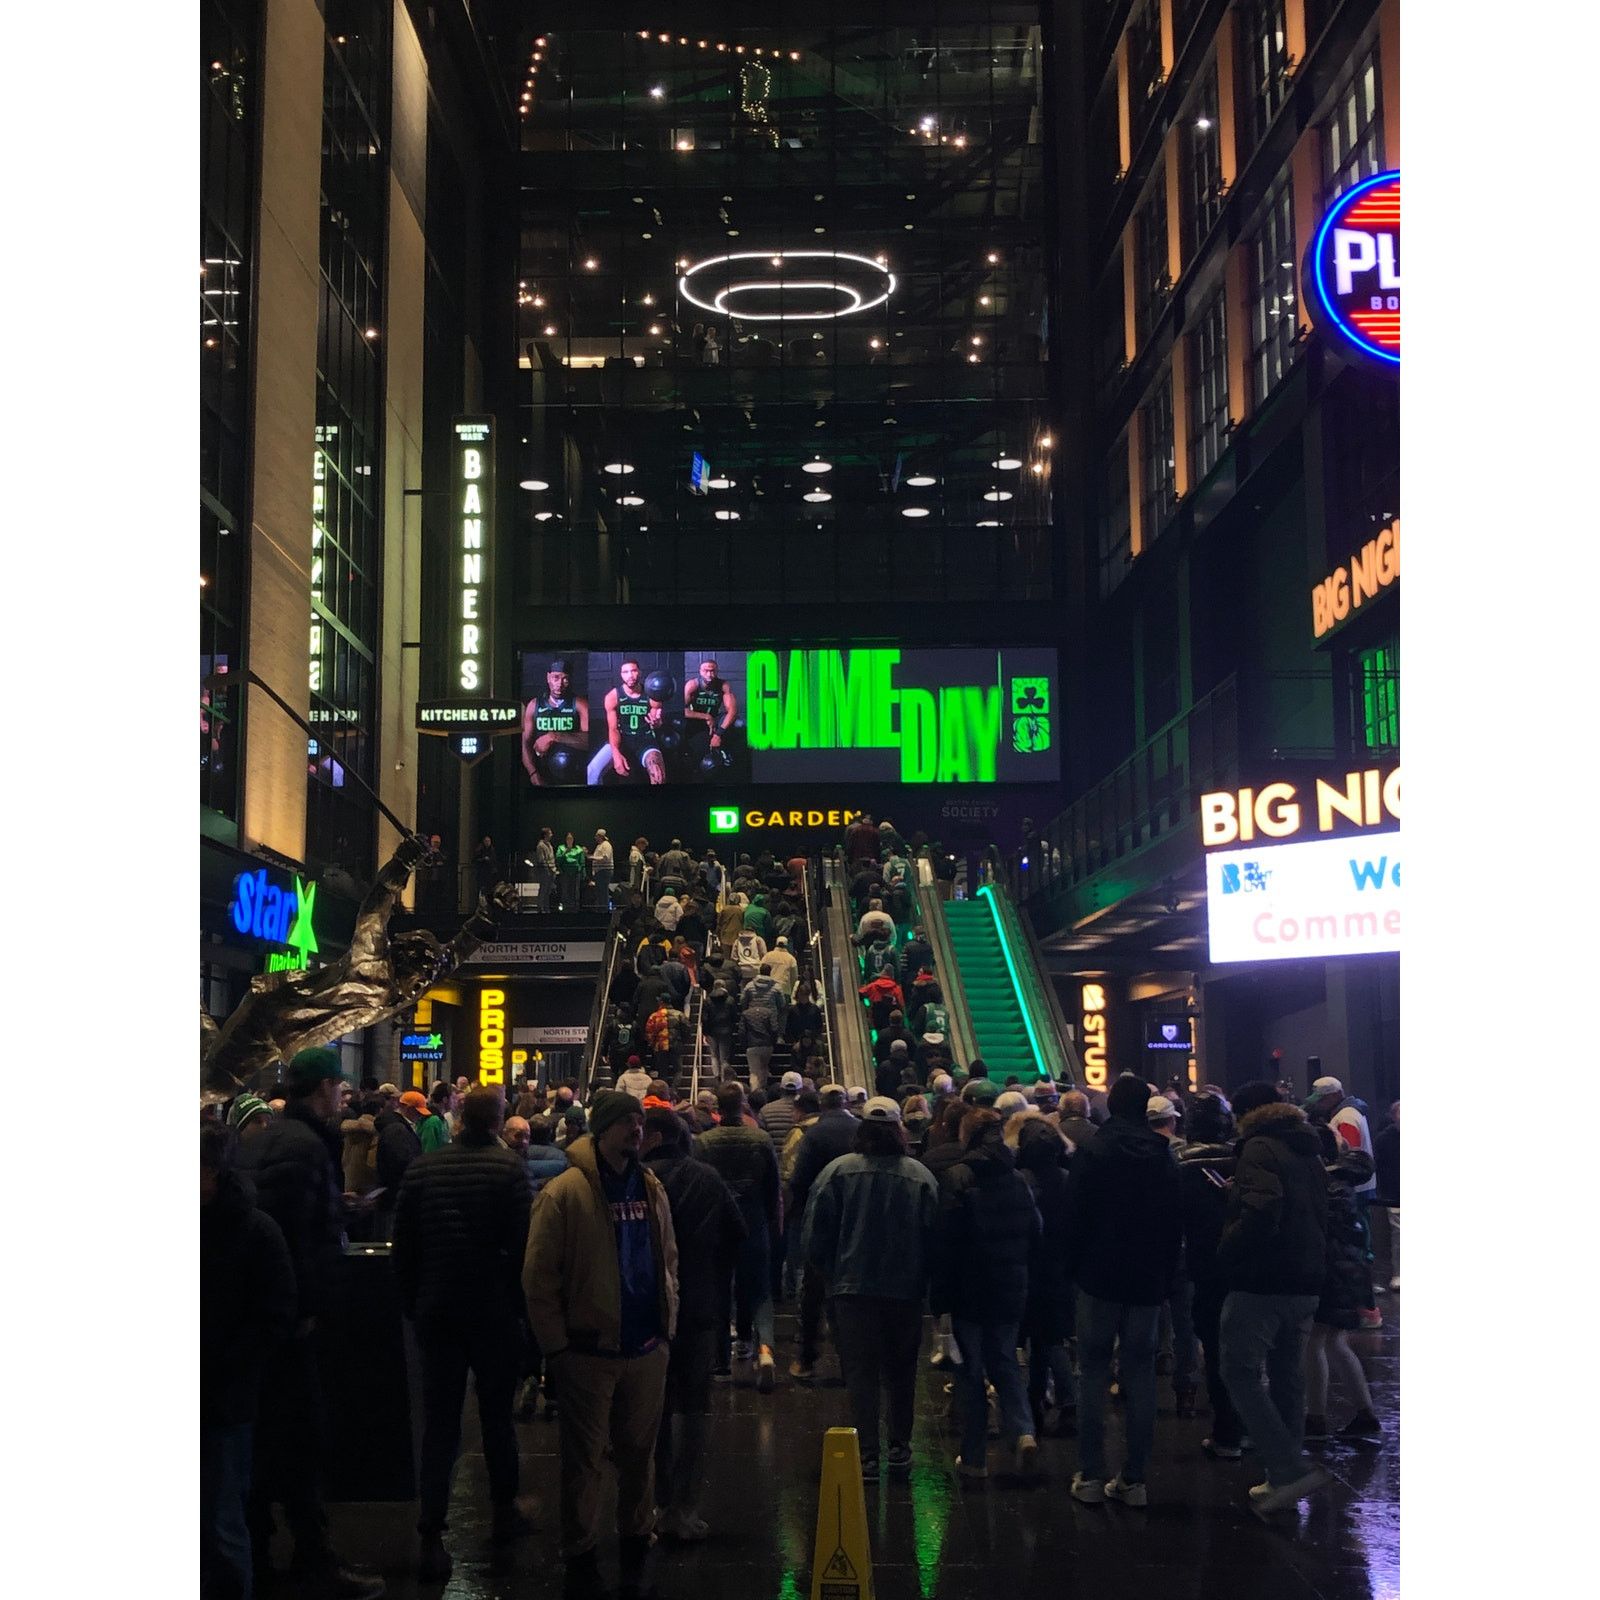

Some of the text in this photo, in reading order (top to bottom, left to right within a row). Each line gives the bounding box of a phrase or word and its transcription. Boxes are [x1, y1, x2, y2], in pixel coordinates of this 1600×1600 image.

[460, 448, 482, 691] BANNERS
[1312, 566, 1350, 638] BIG
[421, 708, 517, 721] KITCHEN & TAP
[620, 704, 648, 715] CELTICS
[747, 649, 1003, 783] GAME DAY
[536, 717, 574, 731] CELTICS
[711, 810, 738, 829] TD
[941, 806, 999, 817] SOCIETY
[1200, 782, 1300, 846] BIG
[233, 868, 297, 945] star
[1253, 909, 1400, 944] Comme
[480, 943, 567, 953] NORTH STATION
[402, 1052, 444, 1060] PHARMACY
